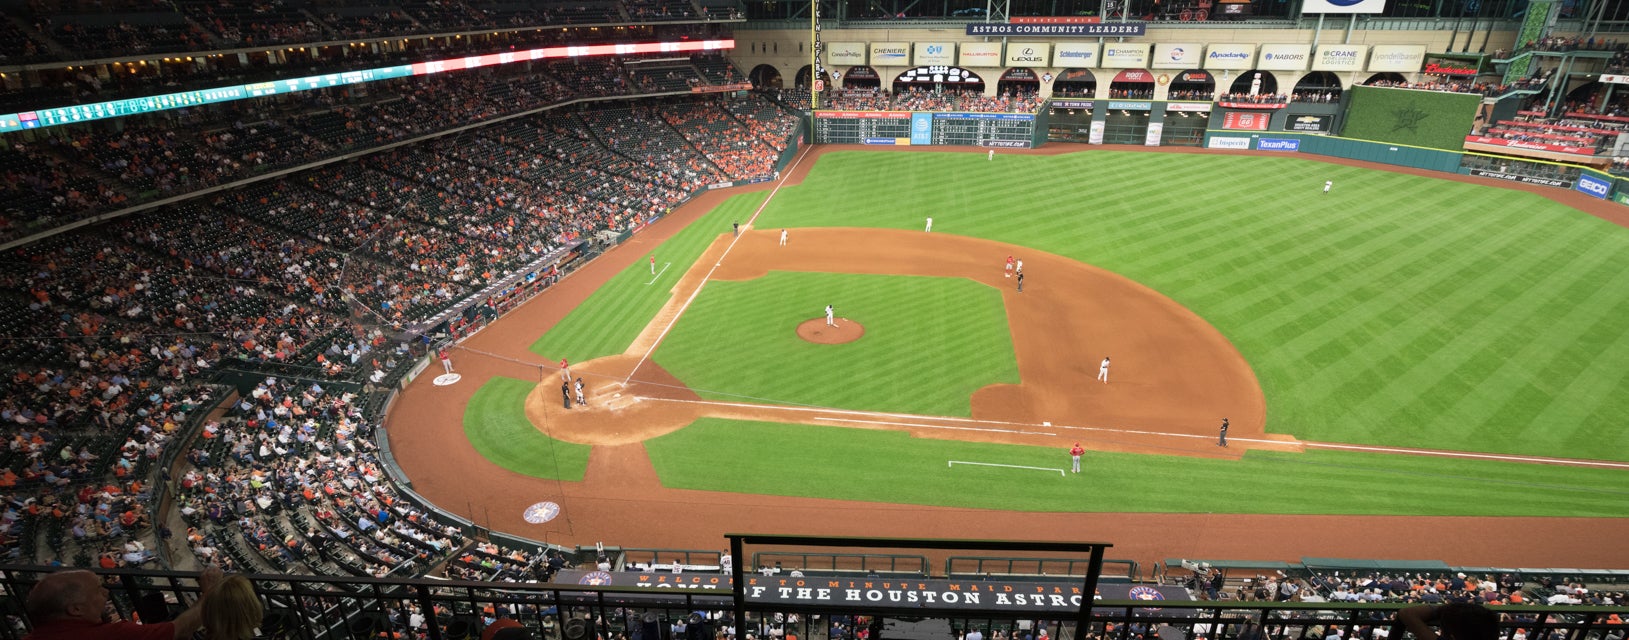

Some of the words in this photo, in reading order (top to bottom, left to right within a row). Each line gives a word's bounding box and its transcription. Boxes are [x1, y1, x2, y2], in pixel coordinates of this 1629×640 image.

[972, 25, 1011, 33] ASTROS
[1016, 25, 1084, 33] COMMUNITY
[1088, 25, 1139, 33] LEADERS
[1059, 50, 1092, 59] Schlumberger
[1209, 51, 1248, 59] Anadarko
[1425, 63, 1477, 75] Budweiser
[1219, 139, 1248, 148] Insperity
[1260, 140, 1297, 149] TexanPlus
[1580, 178, 1607, 195] GEICO
[639, 575, 757, 587] WELCOE
[780, 579, 805, 587] TO
[829, 580, 926, 590] MINUTE
[949, 584, 1013, 593] MAID
[779, 587, 831, 600] THE
[846, 589, 981, 604] HOUSTON
[996, 592, 1102, 607] ASTRO
